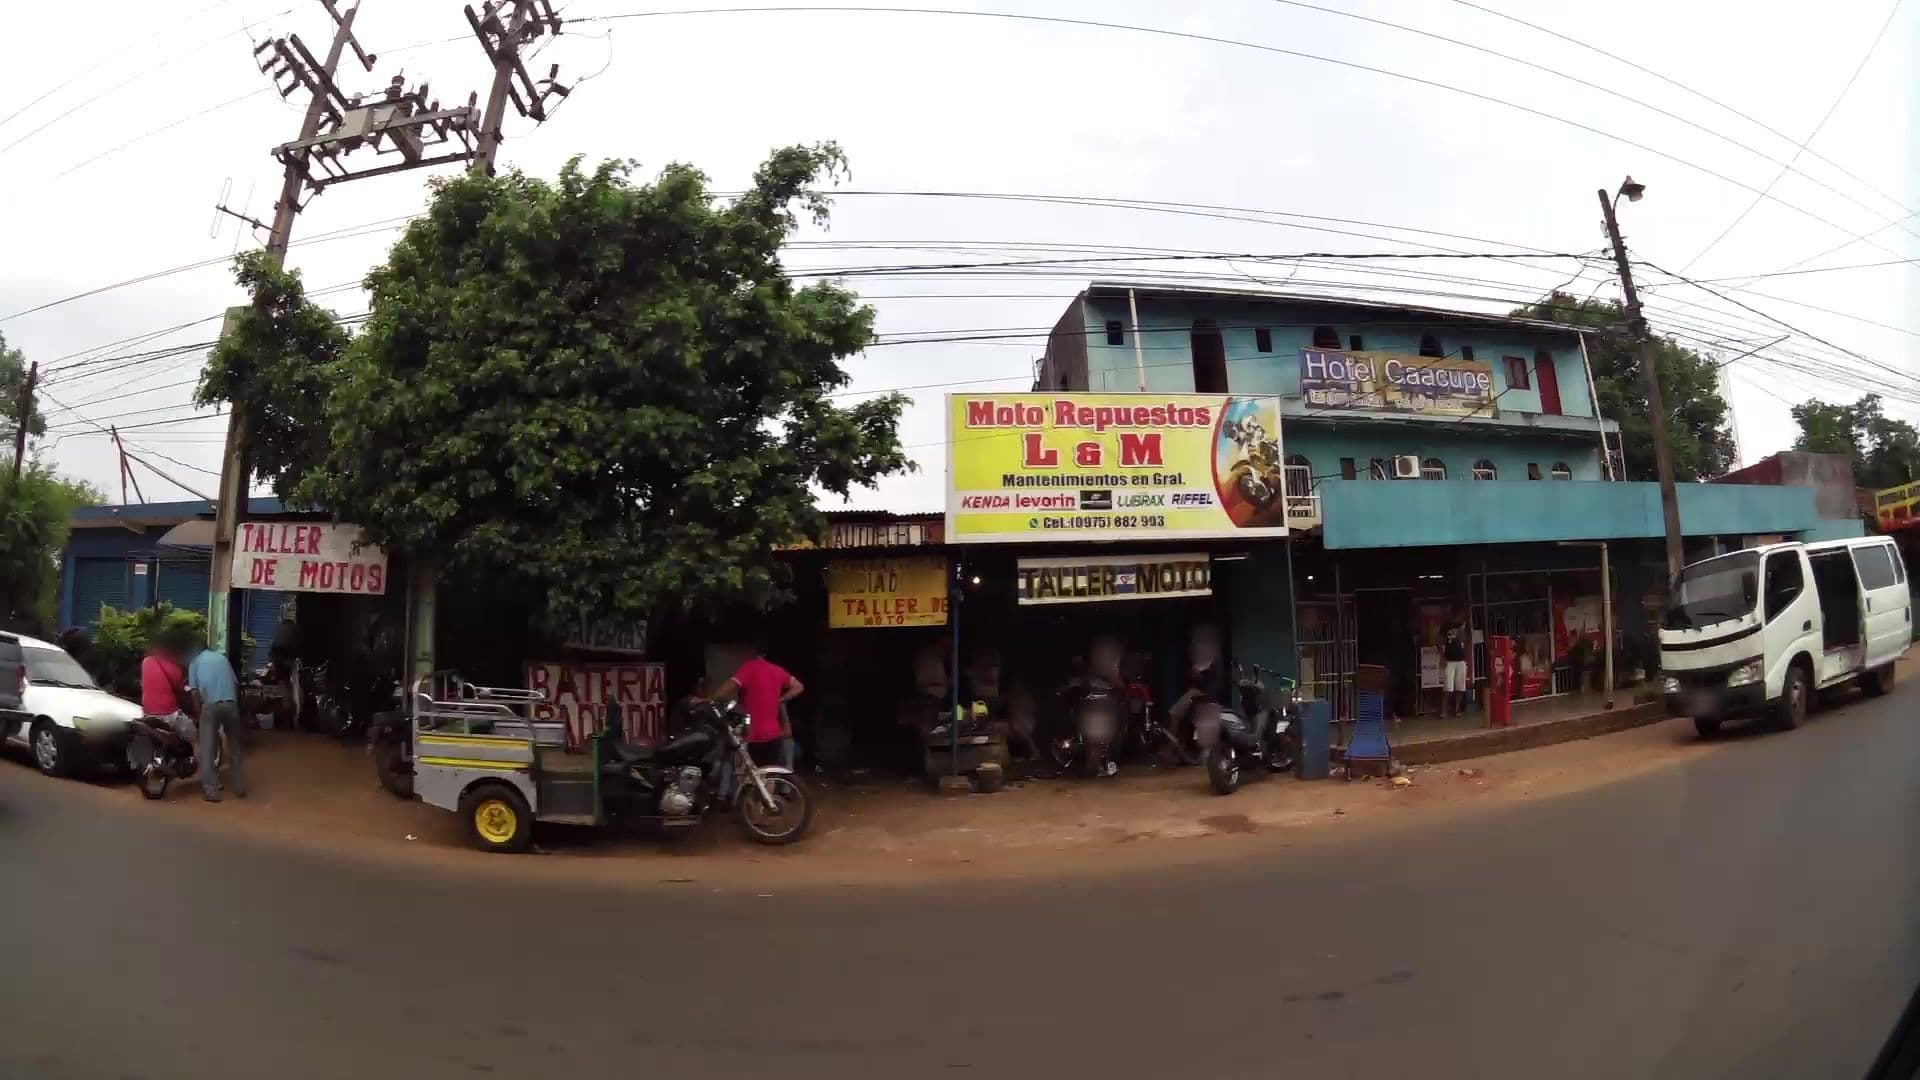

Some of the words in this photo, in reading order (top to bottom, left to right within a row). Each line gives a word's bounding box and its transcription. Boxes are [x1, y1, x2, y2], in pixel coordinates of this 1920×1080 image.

[1305, 354, 1376, 381] Hotel
[1385, 359, 1490, 395] Caacupe
[967, 400, 1045, 427] Moto
[1053, 399, 1212, 432] Repuestos
[1024, 433, 1059, 467] L
[1075, 441, 1103, 467] &
[1119, 433, 1165, 466] M
[1002, 474, 1128, 488] Mantenimientos
[1131, 475, 1149, 486] en
[1153, 472, 1187, 486] Gral.
[961, 495, 1010, 509] KENDA
[1016, 493, 1076, 508] levorin
[1171, 493, 1214, 505] RIFFEL
[242, 523, 322, 555] TALLER
[250, 558, 278, 585] DE
[299, 560, 383, 593] MOTOS
[1019, 564, 1117, 599] TALLER
[841, 597, 918, 616] TALLER
[931, 597, 950, 614] DE
[863, 615, 905, 626] MOTO
